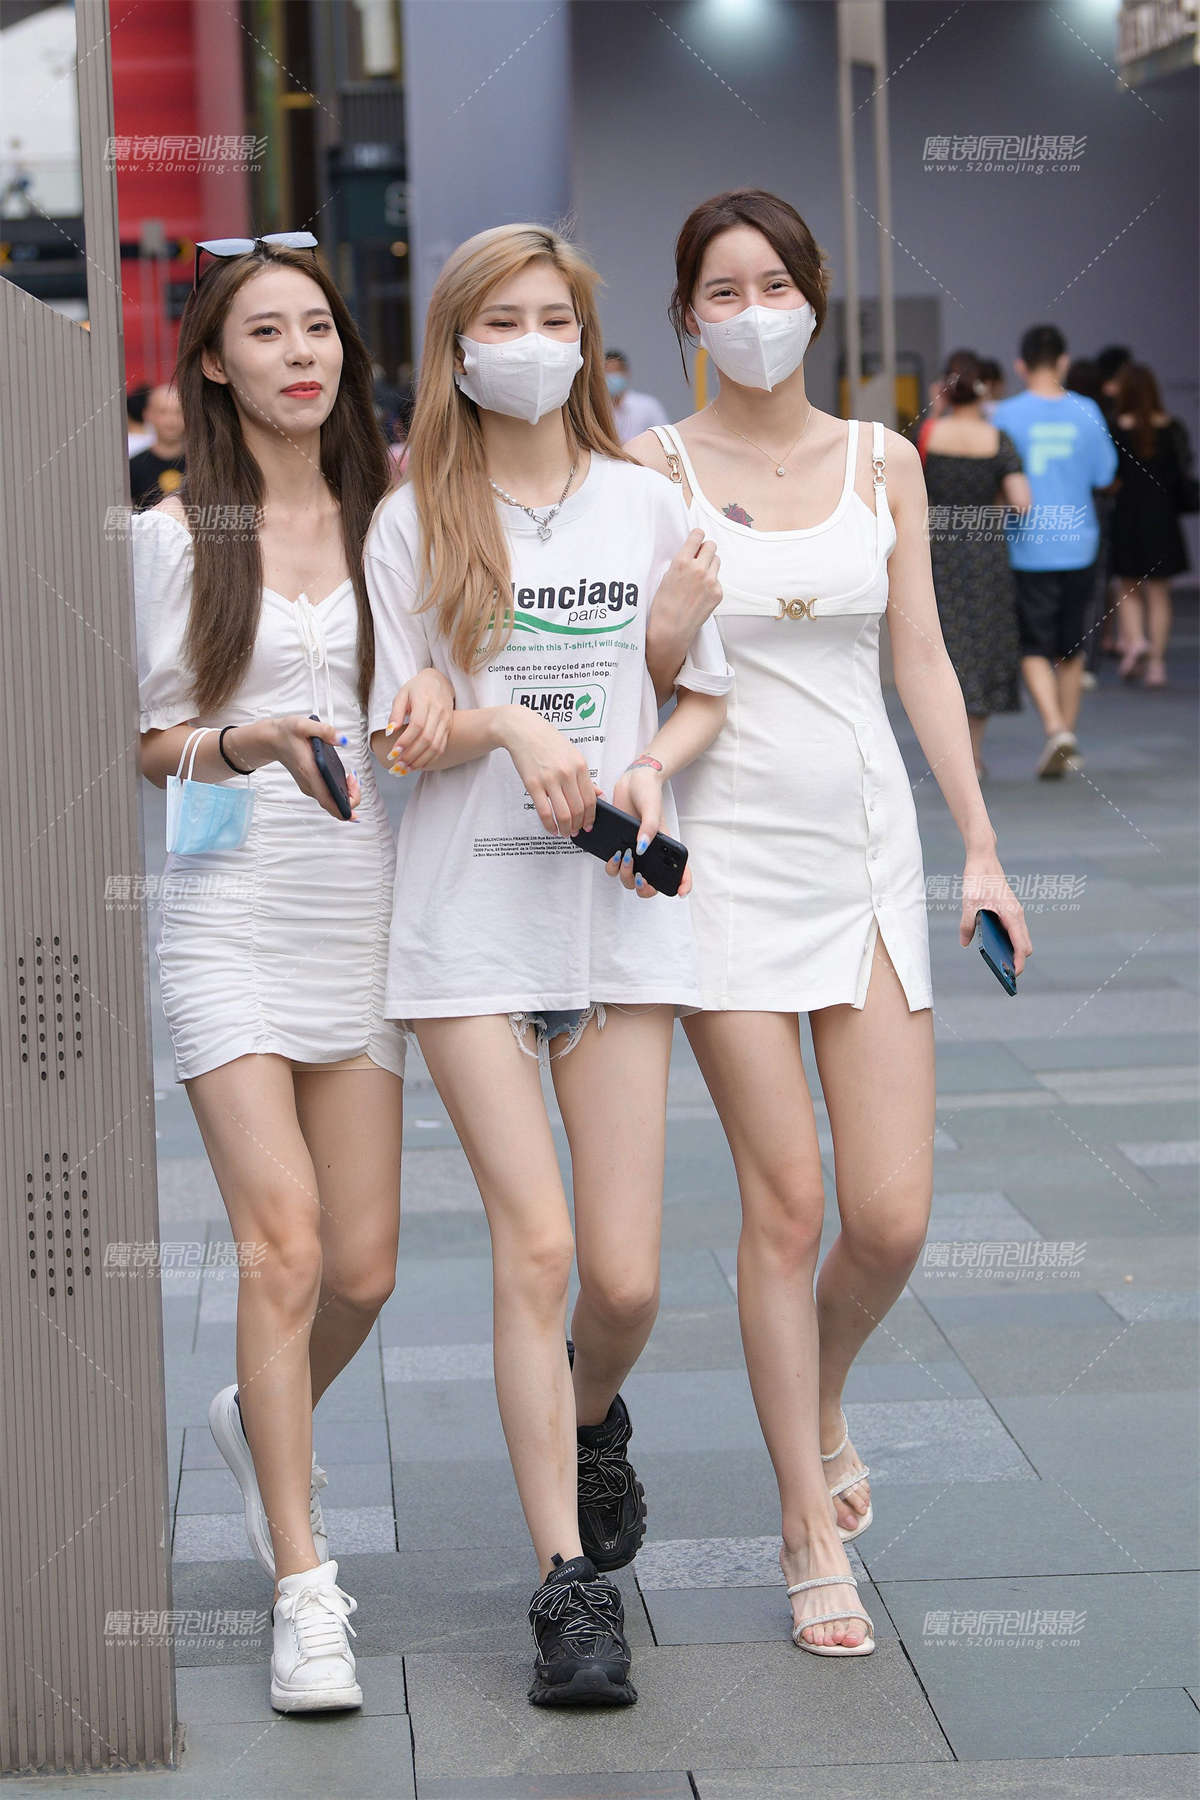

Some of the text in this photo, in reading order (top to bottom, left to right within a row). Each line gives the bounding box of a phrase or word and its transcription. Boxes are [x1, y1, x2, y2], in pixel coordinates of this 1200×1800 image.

[511, 578, 639, 612] lenciaga
[567, 606, 607, 625] paris
[546, 643, 562, 651] this
[544, 662, 579, 672] recycled
[581, 661, 595, 669] and
[561, 671, 591, 680] fashion
[604, 1541, 614, 1550] 37
